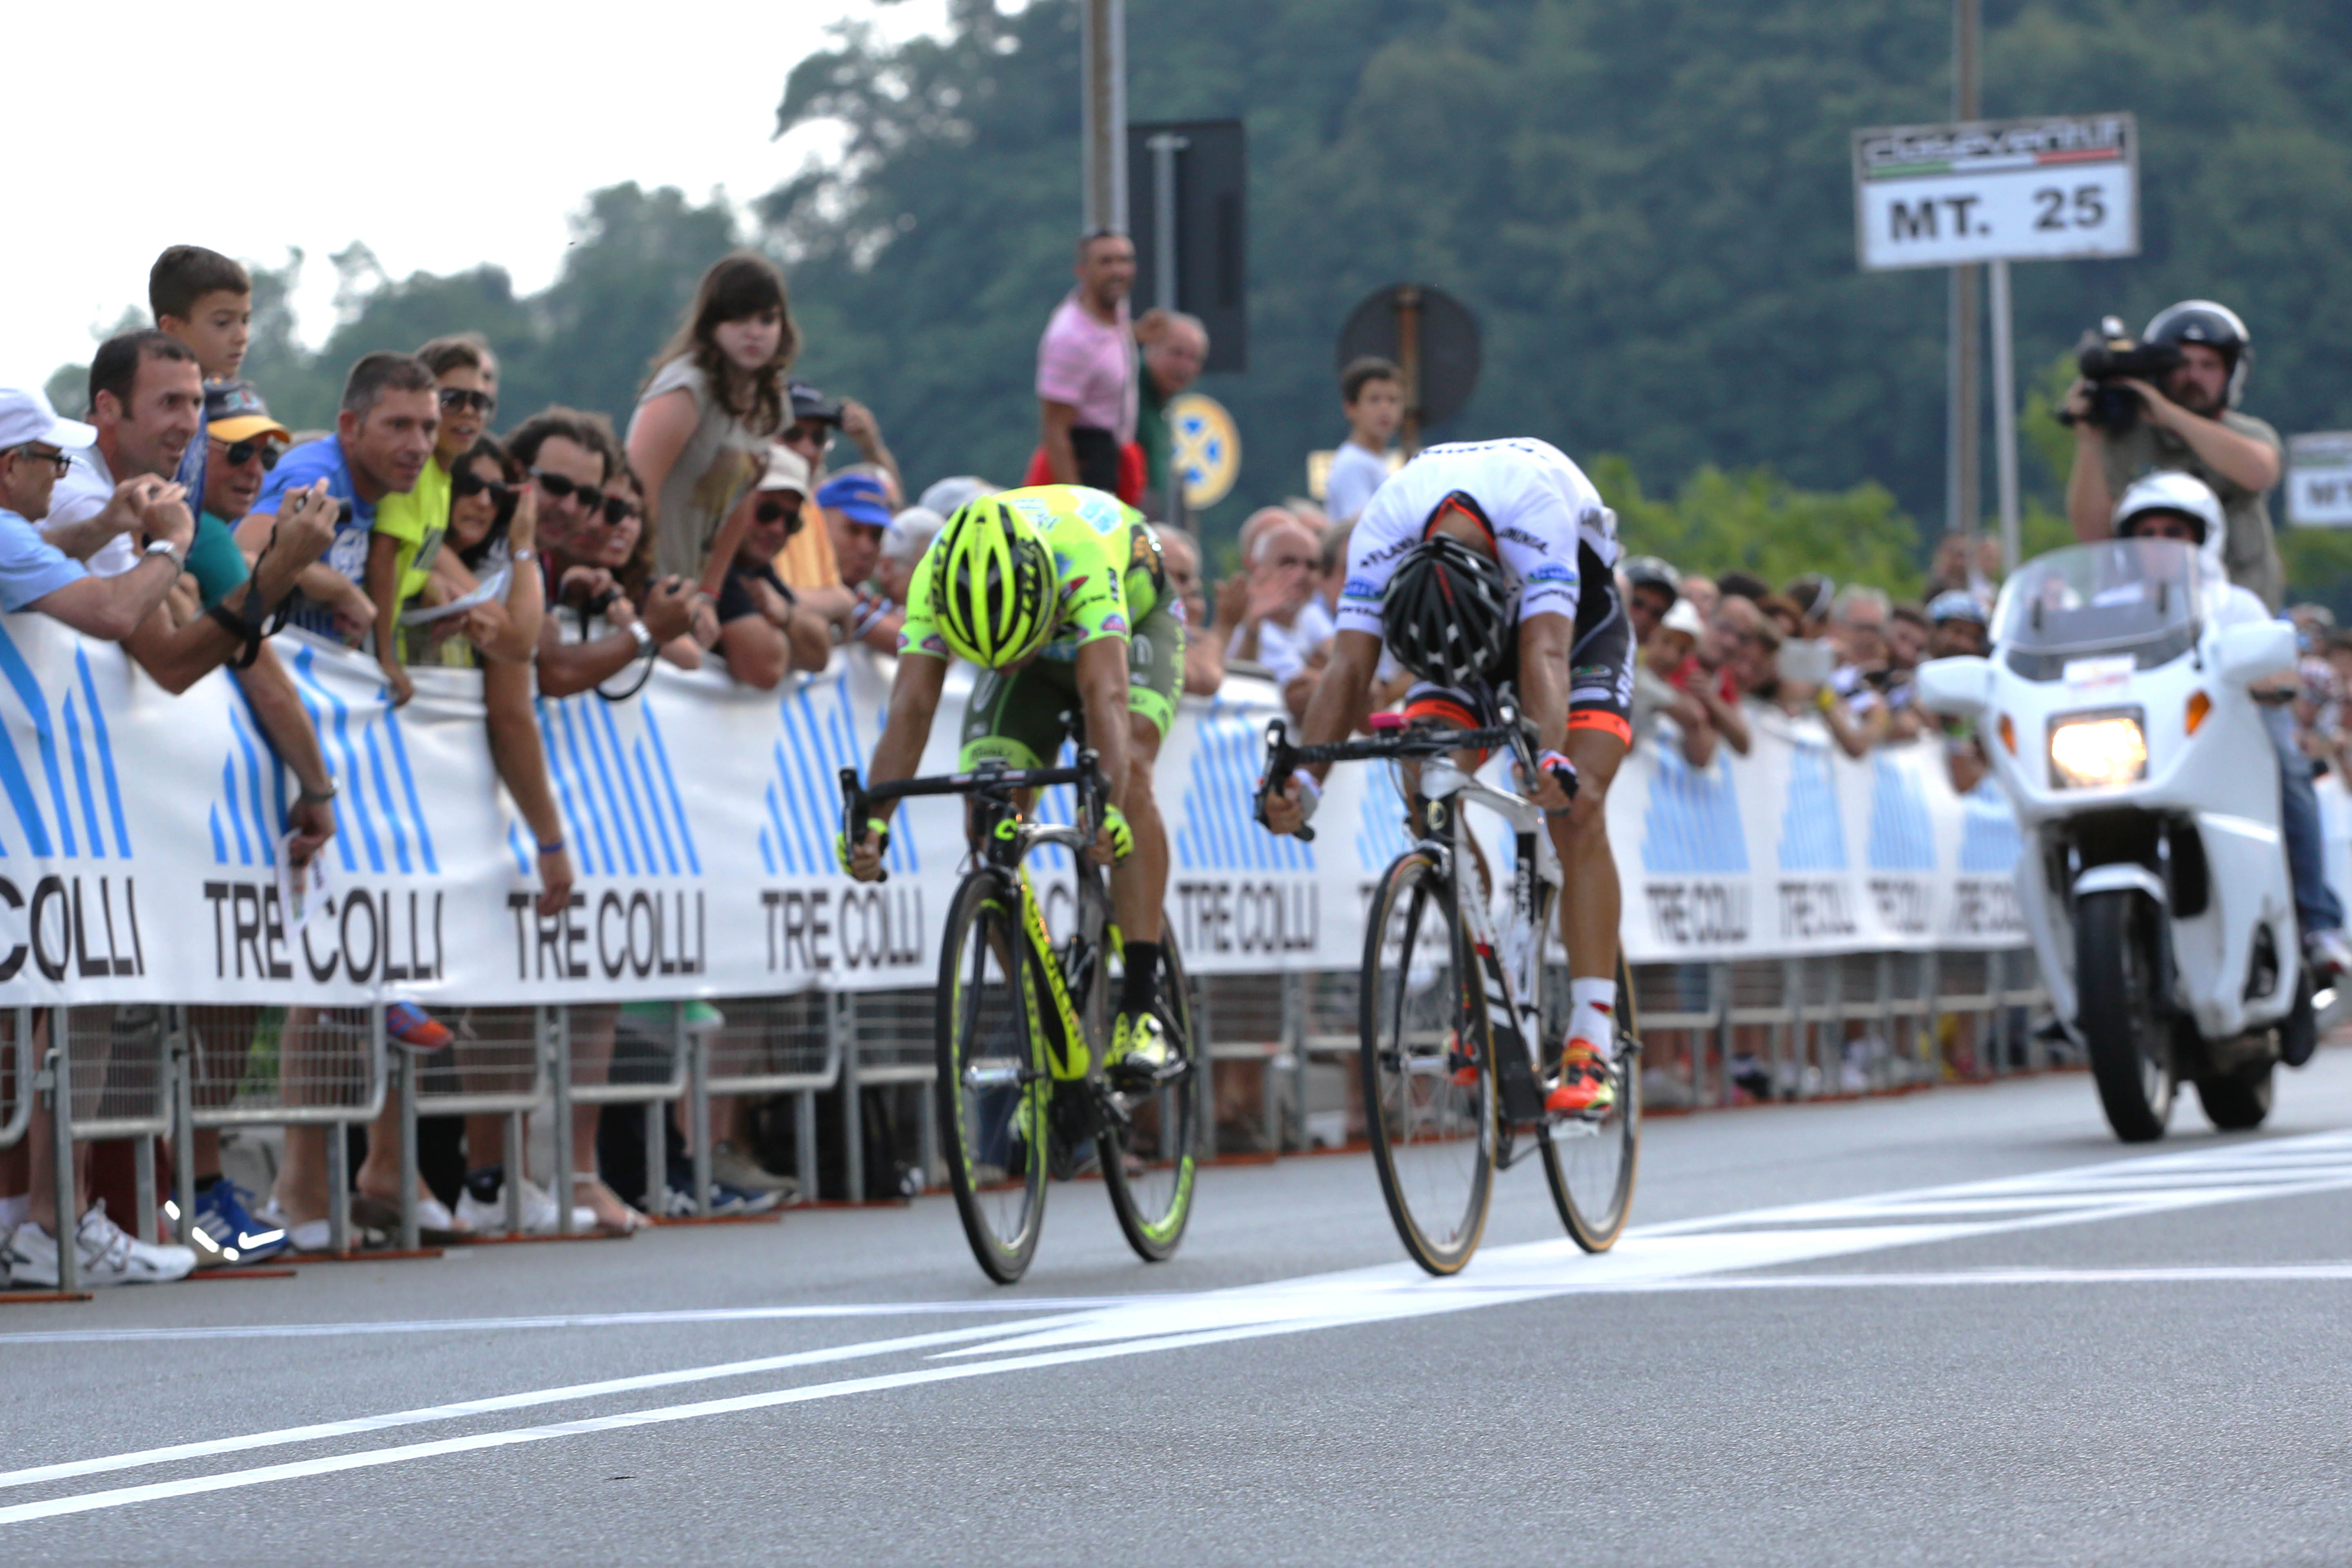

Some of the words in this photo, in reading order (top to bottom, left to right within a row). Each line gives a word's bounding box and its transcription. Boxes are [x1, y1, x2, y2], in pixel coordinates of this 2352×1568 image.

[1888, 193, 1991, 242] MT.
[2032, 185, 2107, 232] 25
[203, 880, 293, 979] TRE
[506, 890, 588, 981] TRE
[597, 889, 705, 978] COLLI
[760, 889, 832, 973] TRE
[838, 887, 924, 969] COLLI
[1175, 880, 1232, 953] TRE
[1236, 880, 1319, 953] COLLI
